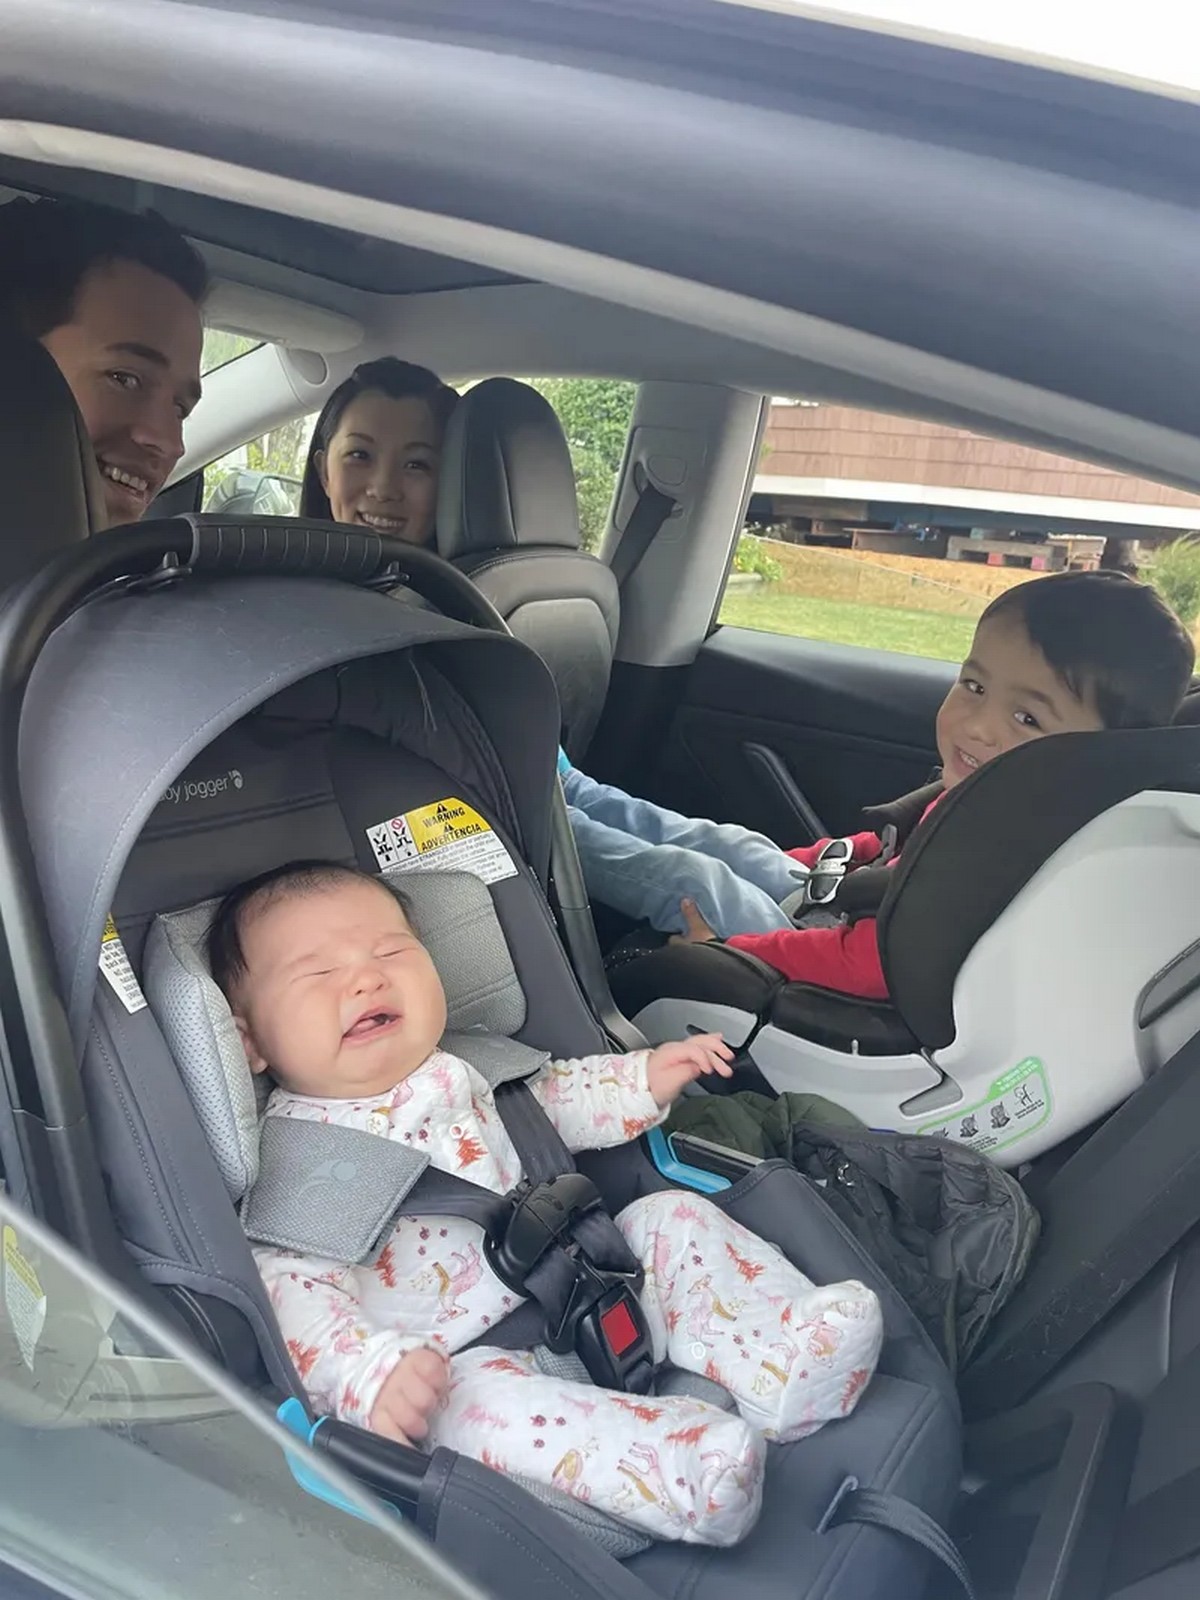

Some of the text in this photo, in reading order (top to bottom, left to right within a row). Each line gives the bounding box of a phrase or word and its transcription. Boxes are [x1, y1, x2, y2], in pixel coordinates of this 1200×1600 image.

[184, 777, 228, 801] jogger
[422, 807, 466, 828] WARNING
[421, 823, 482, 851] ADVERTENCIA
